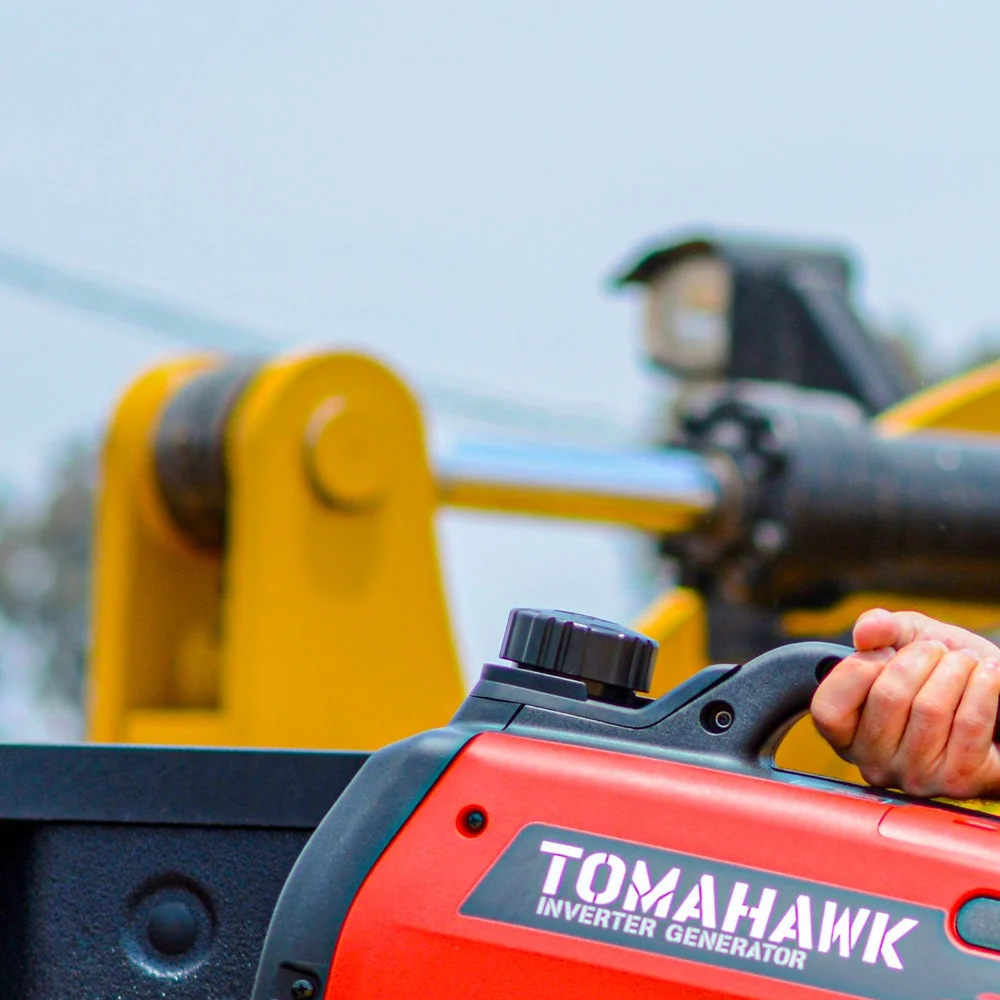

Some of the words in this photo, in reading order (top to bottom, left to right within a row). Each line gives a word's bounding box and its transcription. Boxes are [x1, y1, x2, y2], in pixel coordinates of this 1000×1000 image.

[536, 896, 657, 938] INVERTER
[665, 923, 807, 970] GENERATOR
[540, 840, 919, 970] TOMAHAWK
